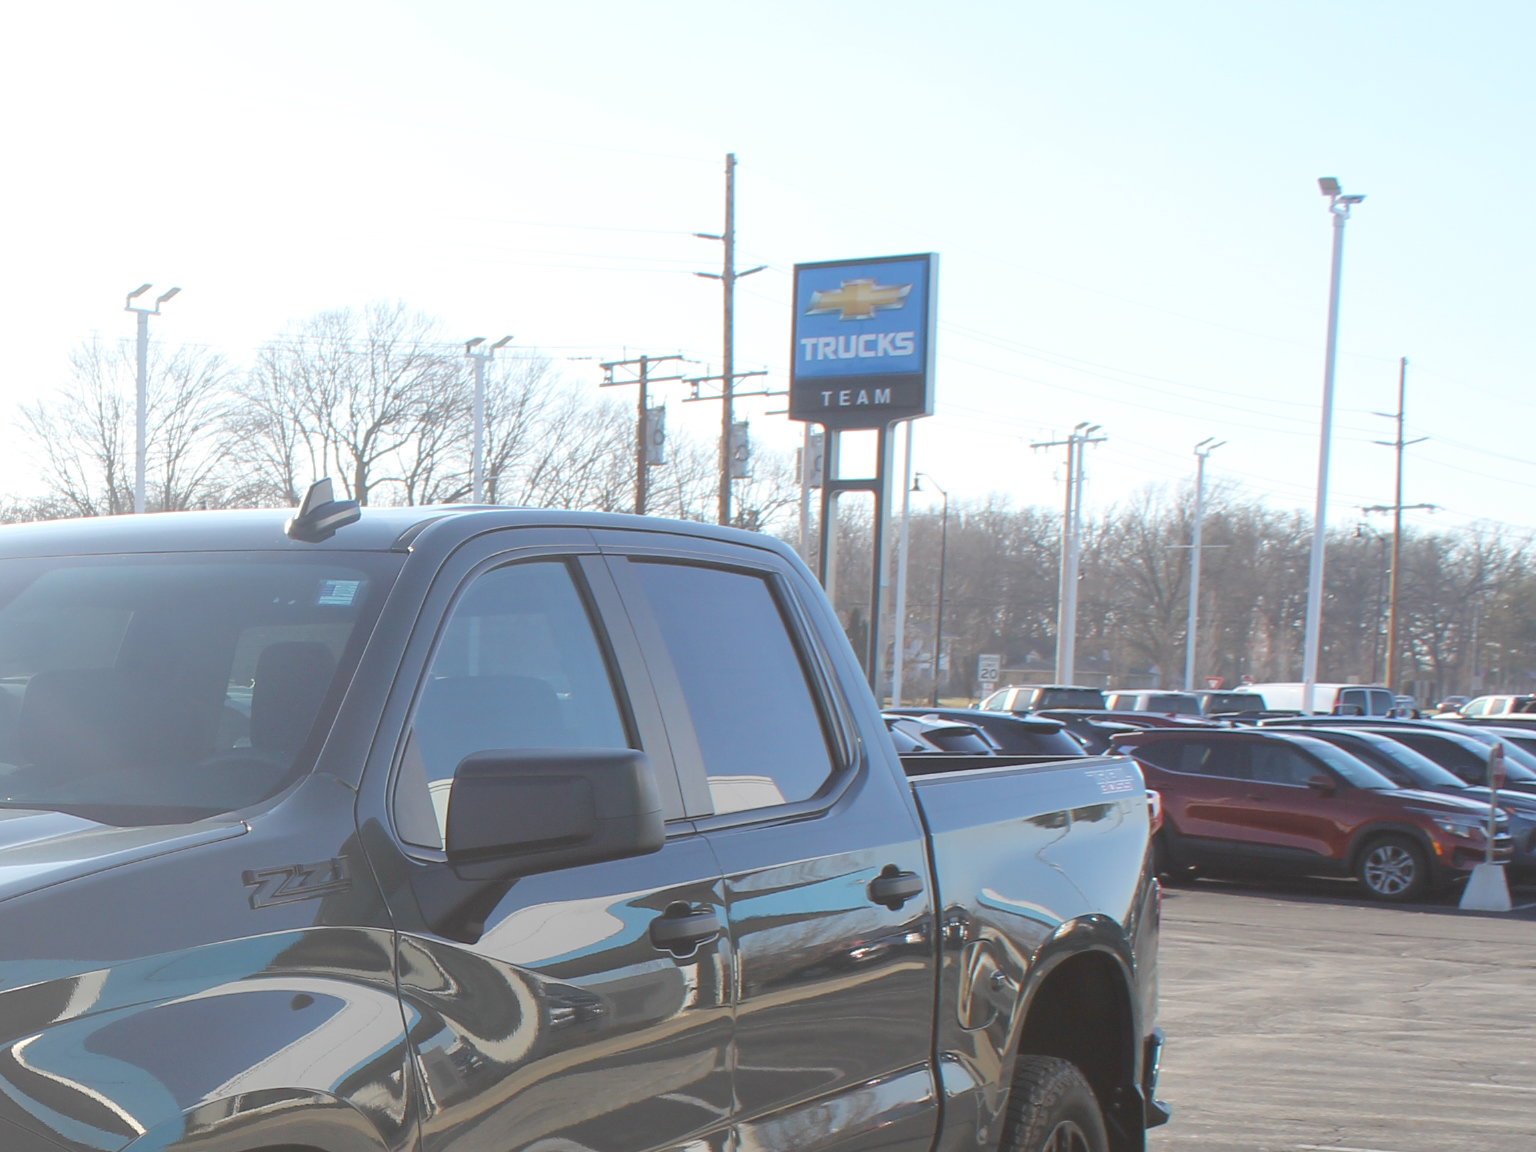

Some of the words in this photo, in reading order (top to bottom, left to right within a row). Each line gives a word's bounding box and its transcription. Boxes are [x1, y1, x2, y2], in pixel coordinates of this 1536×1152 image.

[800, 332, 914, 361] TRUCKS
[821, 388, 891, 407] TEAM
[980, 668, 997, 680] 20
